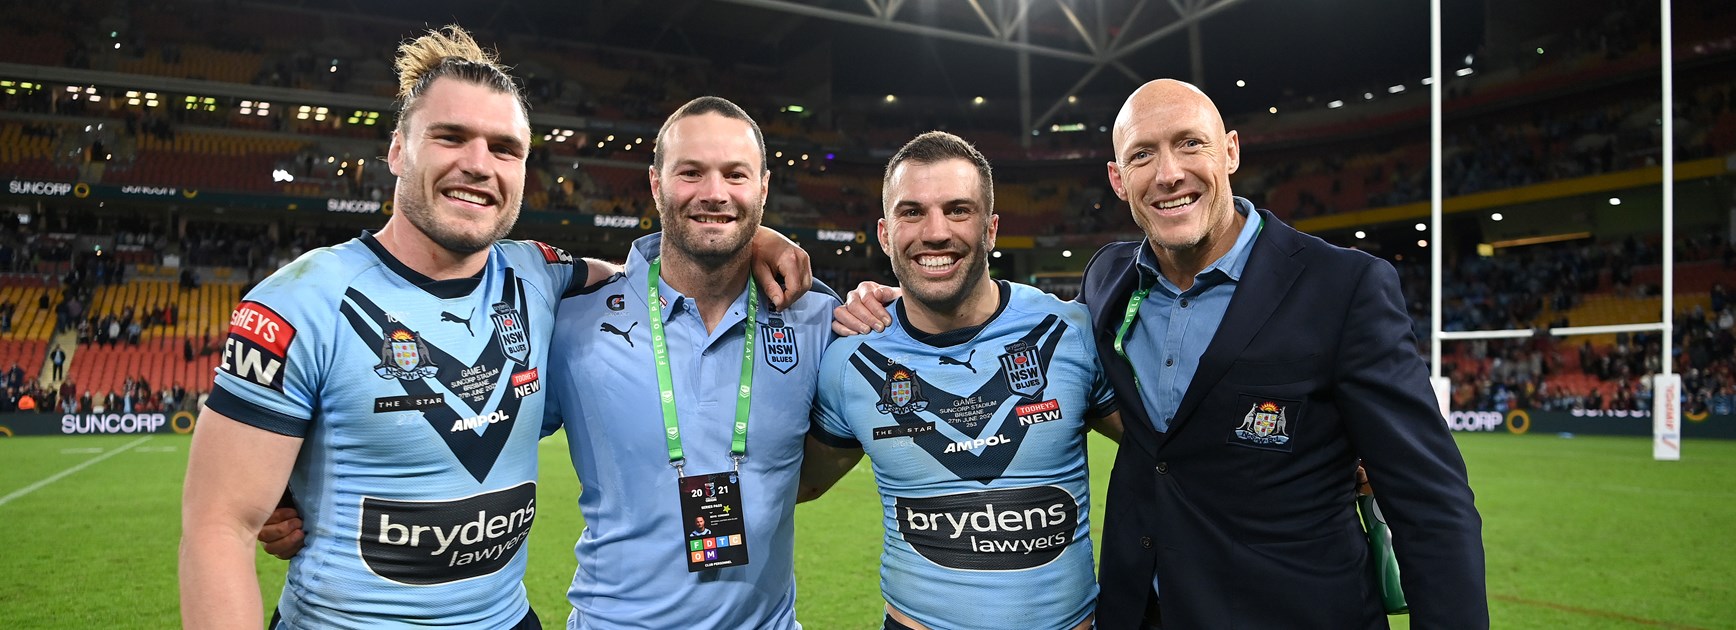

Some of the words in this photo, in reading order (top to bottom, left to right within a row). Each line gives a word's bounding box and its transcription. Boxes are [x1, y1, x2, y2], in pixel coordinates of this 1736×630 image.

[9, 180, 71, 196] SUNCORP
[606, 294, 625, 312] G
[649, 286, 658, 312] PLAY
[653, 317, 661, 330] OF
[502, 331, 524, 346] NSW
[508, 344, 527, 354] BLUES
[655, 335, 667, 366] FIELD
[768, 344, 793, 355] NSW
[221, 337, 282, 386] EW
[771, 356, 794, 364] BLUES
[461, 364, 482, 378] GAME
[514, 370, 537, 384] TOOHEYS
[1009, 367, 1039, 383] NSW
[514, 379, 540, 399] NEW
[1015, 379, 1041, 390] BLUES
[379, 400, 401, 408] THE
[415, 397, 442, 406] STAR
[939, 406, 970, 415] SUNCORP
[970, 400, 998, 411] STADIUM
[953, 396, 977, 407] GAME
[1019, 401, 1055, 414] TOOHEYS
[450, 409, 510, 432] AMPOL
[954, 408, 985, 418] BRISBANE
[962, 415, 978, 423] JUNE
[1018, 410, 1060, 426] NEW
[62, 413, 166, 434] SUNCORP
[875, 429, 893, 437] THE
[907, 425, 933, 433] STAR
[943, 433, 1011, 454] AMPOL
[691, 488, 703, 498] 20
[718, 485, 729, 495] 21
[378, 498, 536, 556] brydens
[904, 503, 1067, 539] brydens
[448, 526, 531, 567] lawyers
[970, 531, 1066, 554] lawyers
